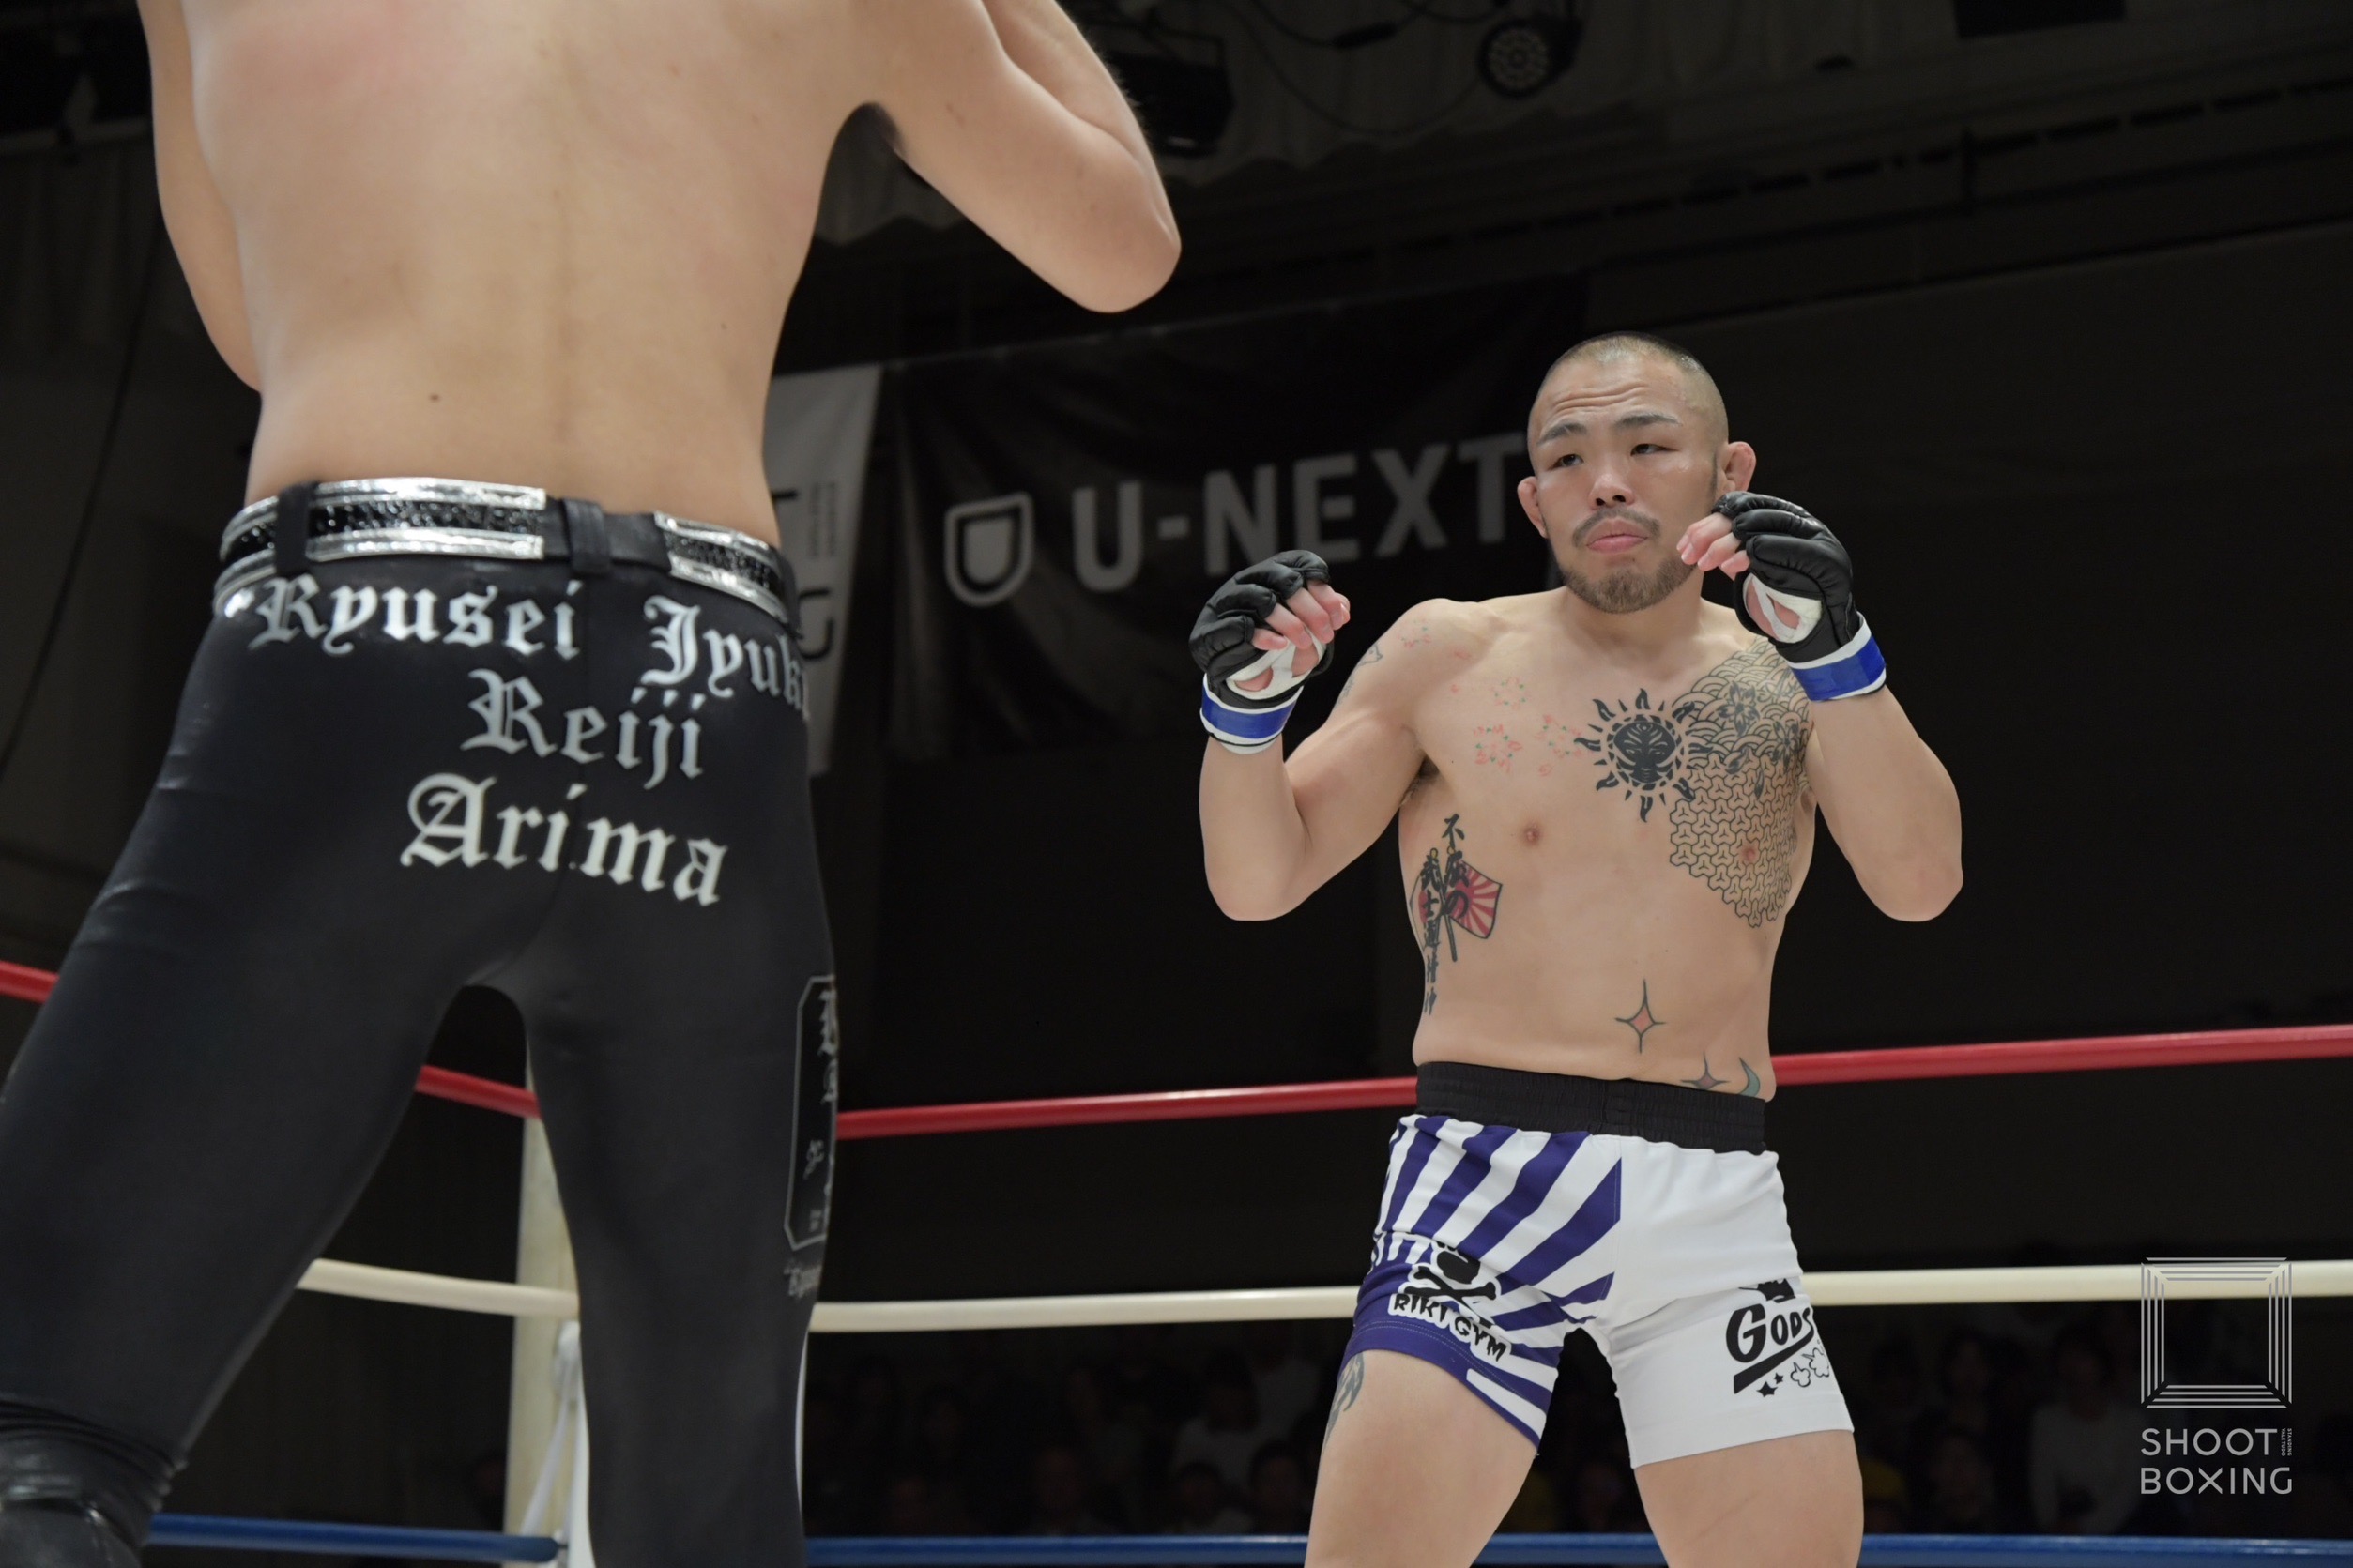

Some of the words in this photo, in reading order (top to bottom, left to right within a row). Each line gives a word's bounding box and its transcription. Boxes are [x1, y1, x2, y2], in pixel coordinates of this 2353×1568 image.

[1070, 432, 1527, 595] U-NEXT
[248, 572, 584, 660] Ryusei
[640, 594, 811, 723] Jyuk
[459, 667, 705, 790] Reiji
[399, 772, 728, 906] Arima
[1393, 1293, 1451, 1323] RIKI
[1454, 1316, 1507, 1362] GYM
